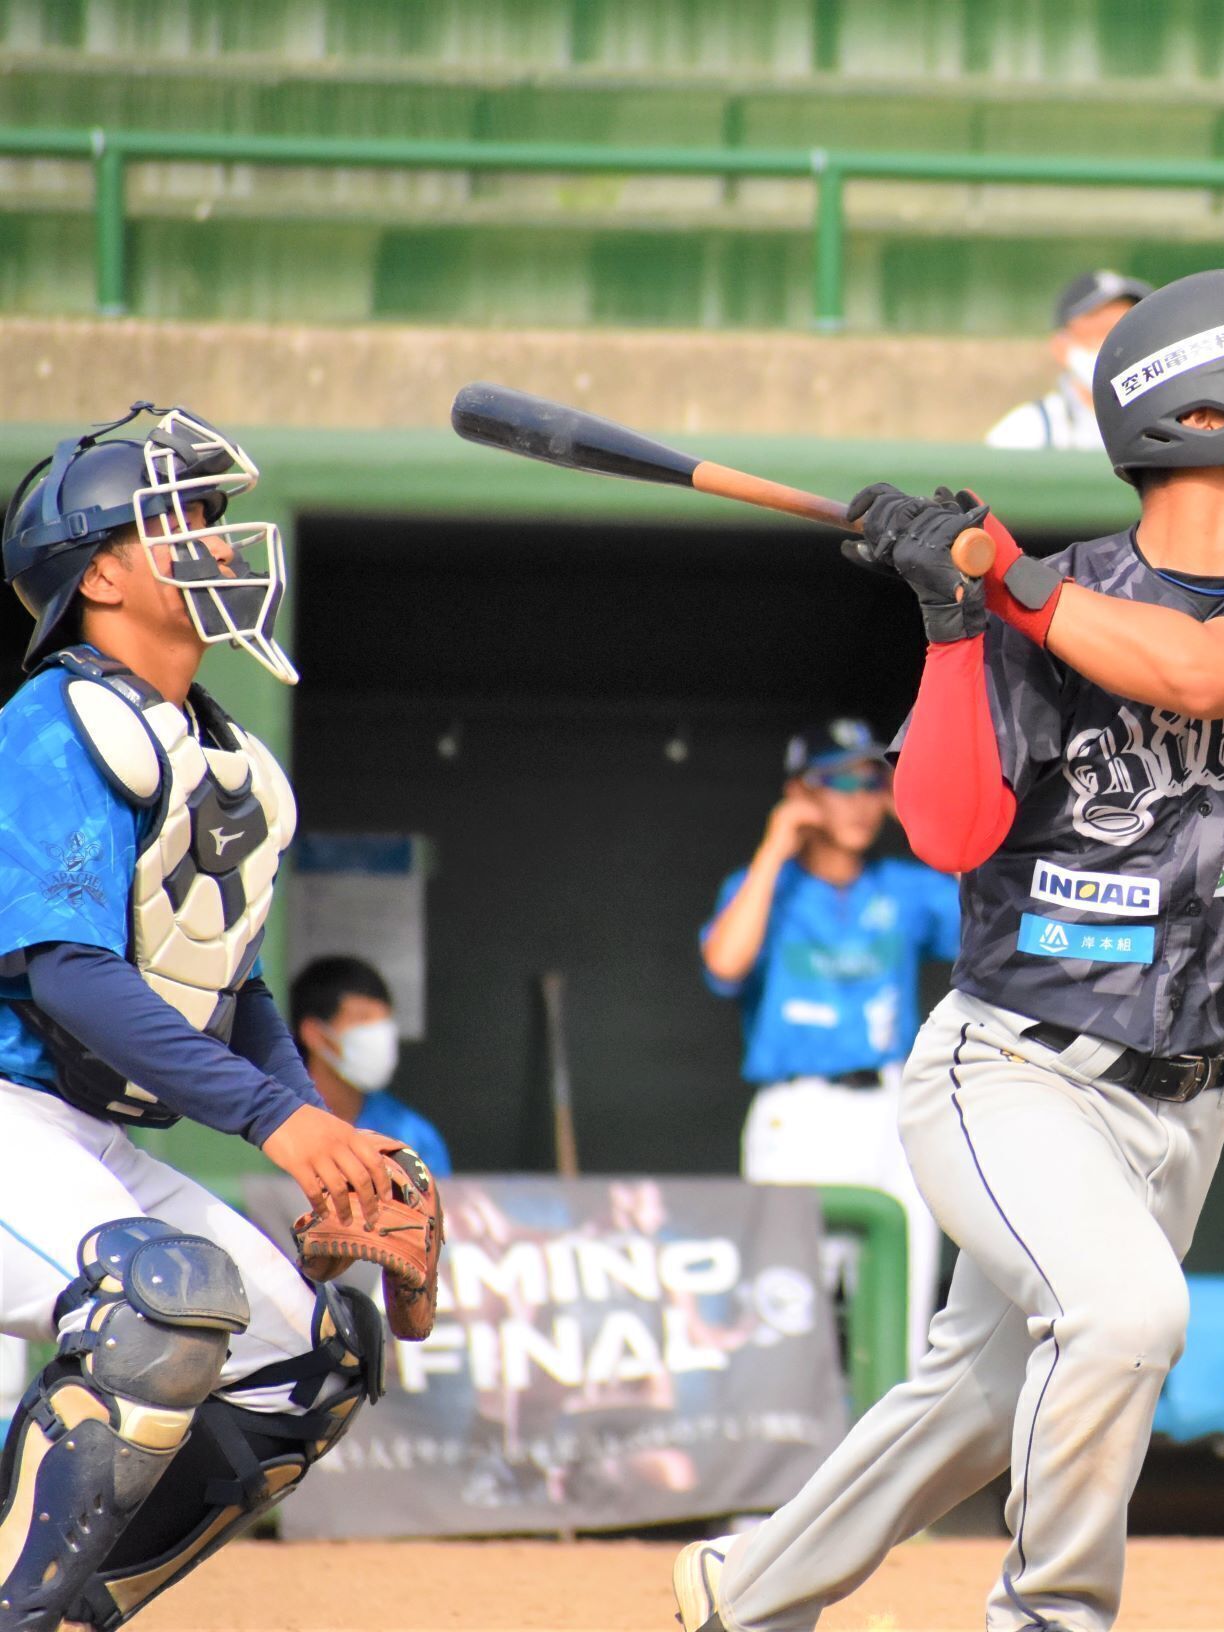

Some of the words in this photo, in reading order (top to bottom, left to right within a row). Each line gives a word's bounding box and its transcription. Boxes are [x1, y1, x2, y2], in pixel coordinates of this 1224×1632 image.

[1039, 869, 1151, 909] INOAC
[1081, 935, 1132, 953] 岸本組
[398, 1309, 729, 1392] FINAL
